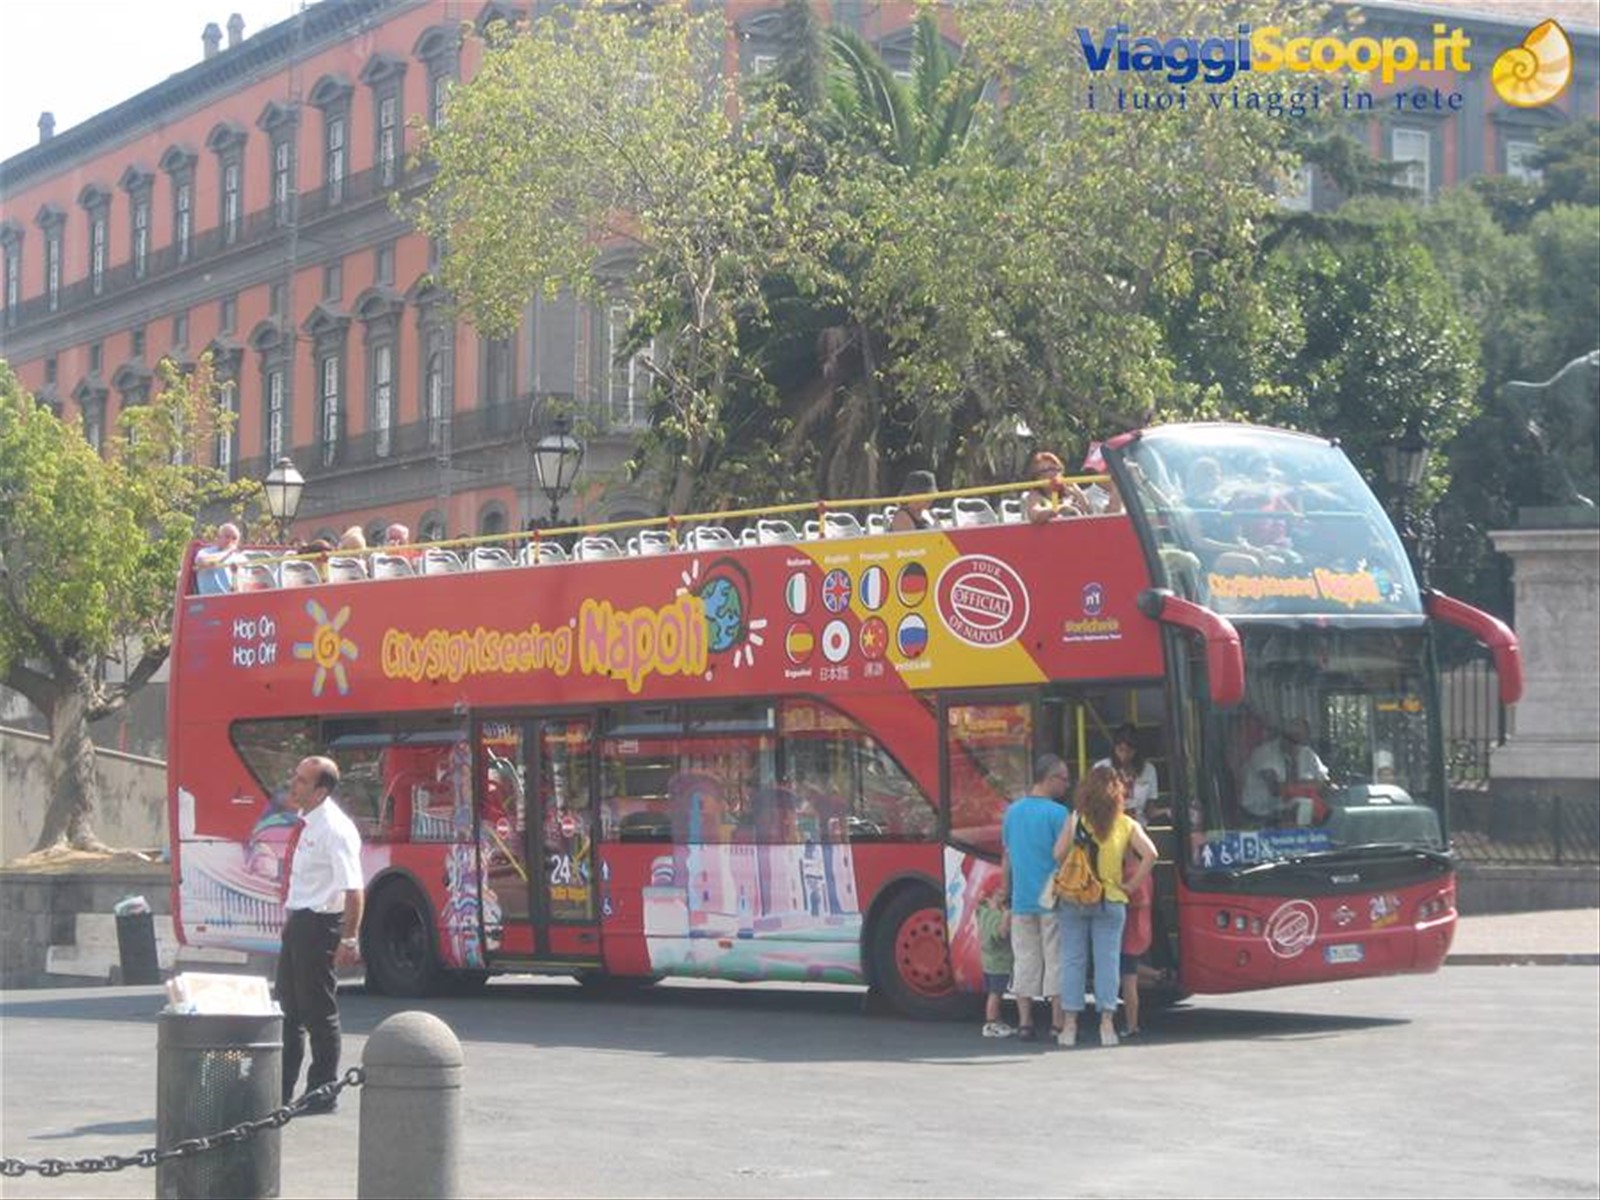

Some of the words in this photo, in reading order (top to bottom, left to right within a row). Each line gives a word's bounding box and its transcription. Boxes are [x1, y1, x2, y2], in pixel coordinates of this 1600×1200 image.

[970, 560, 1002, 577] TOUR
[953, 588, 1008, 615] OFFICIAL
[232, 619, 257, 640] Hop
[258, 615, 276, 638] On
[962, 625, 1004, 643] NAPOLI
[232, 645, 257, 667] Hop
[258, 641, 278, 665] Off
[578, 593, 709, 694] Napoli
[550, 854, 571, 884] 24
